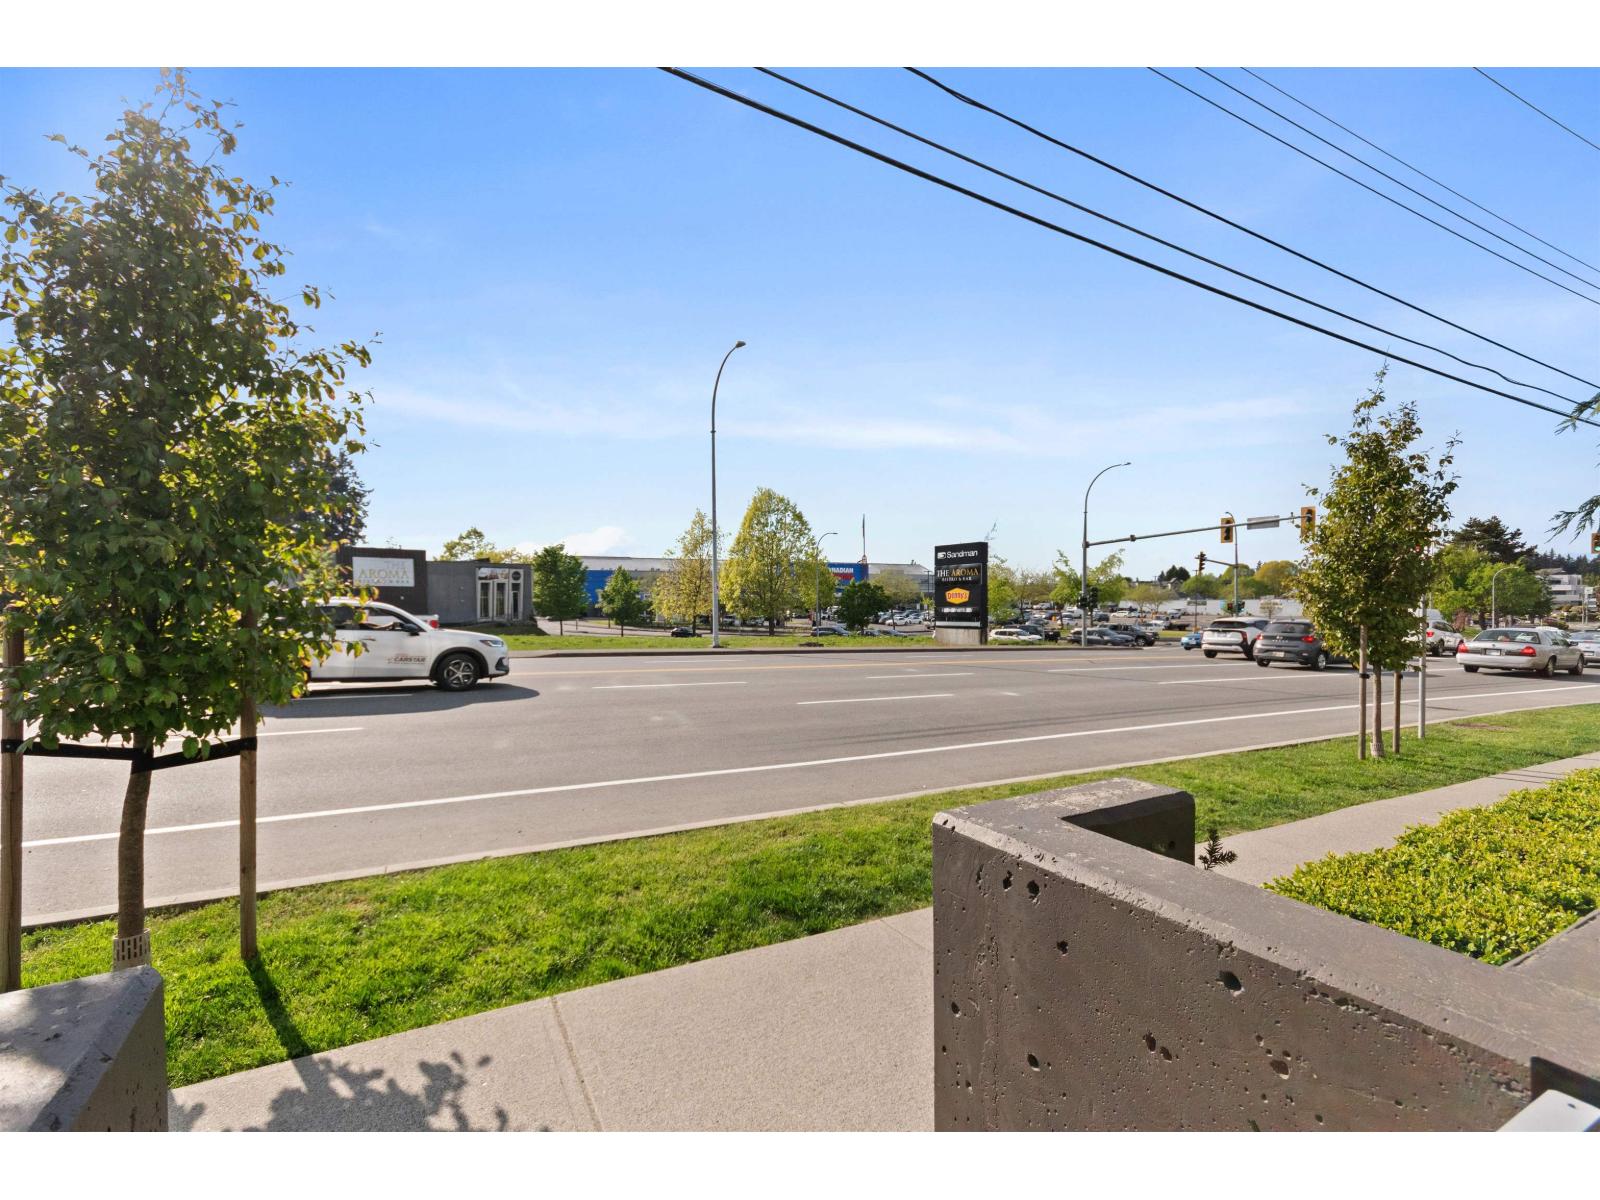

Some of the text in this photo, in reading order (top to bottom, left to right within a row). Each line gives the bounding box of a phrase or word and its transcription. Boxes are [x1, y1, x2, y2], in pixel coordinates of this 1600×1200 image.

[946, 550, 978, 559] Sandman
[358, 568, 409, 579] AROMA
[937, 568, 979, 577] THE AROMA
